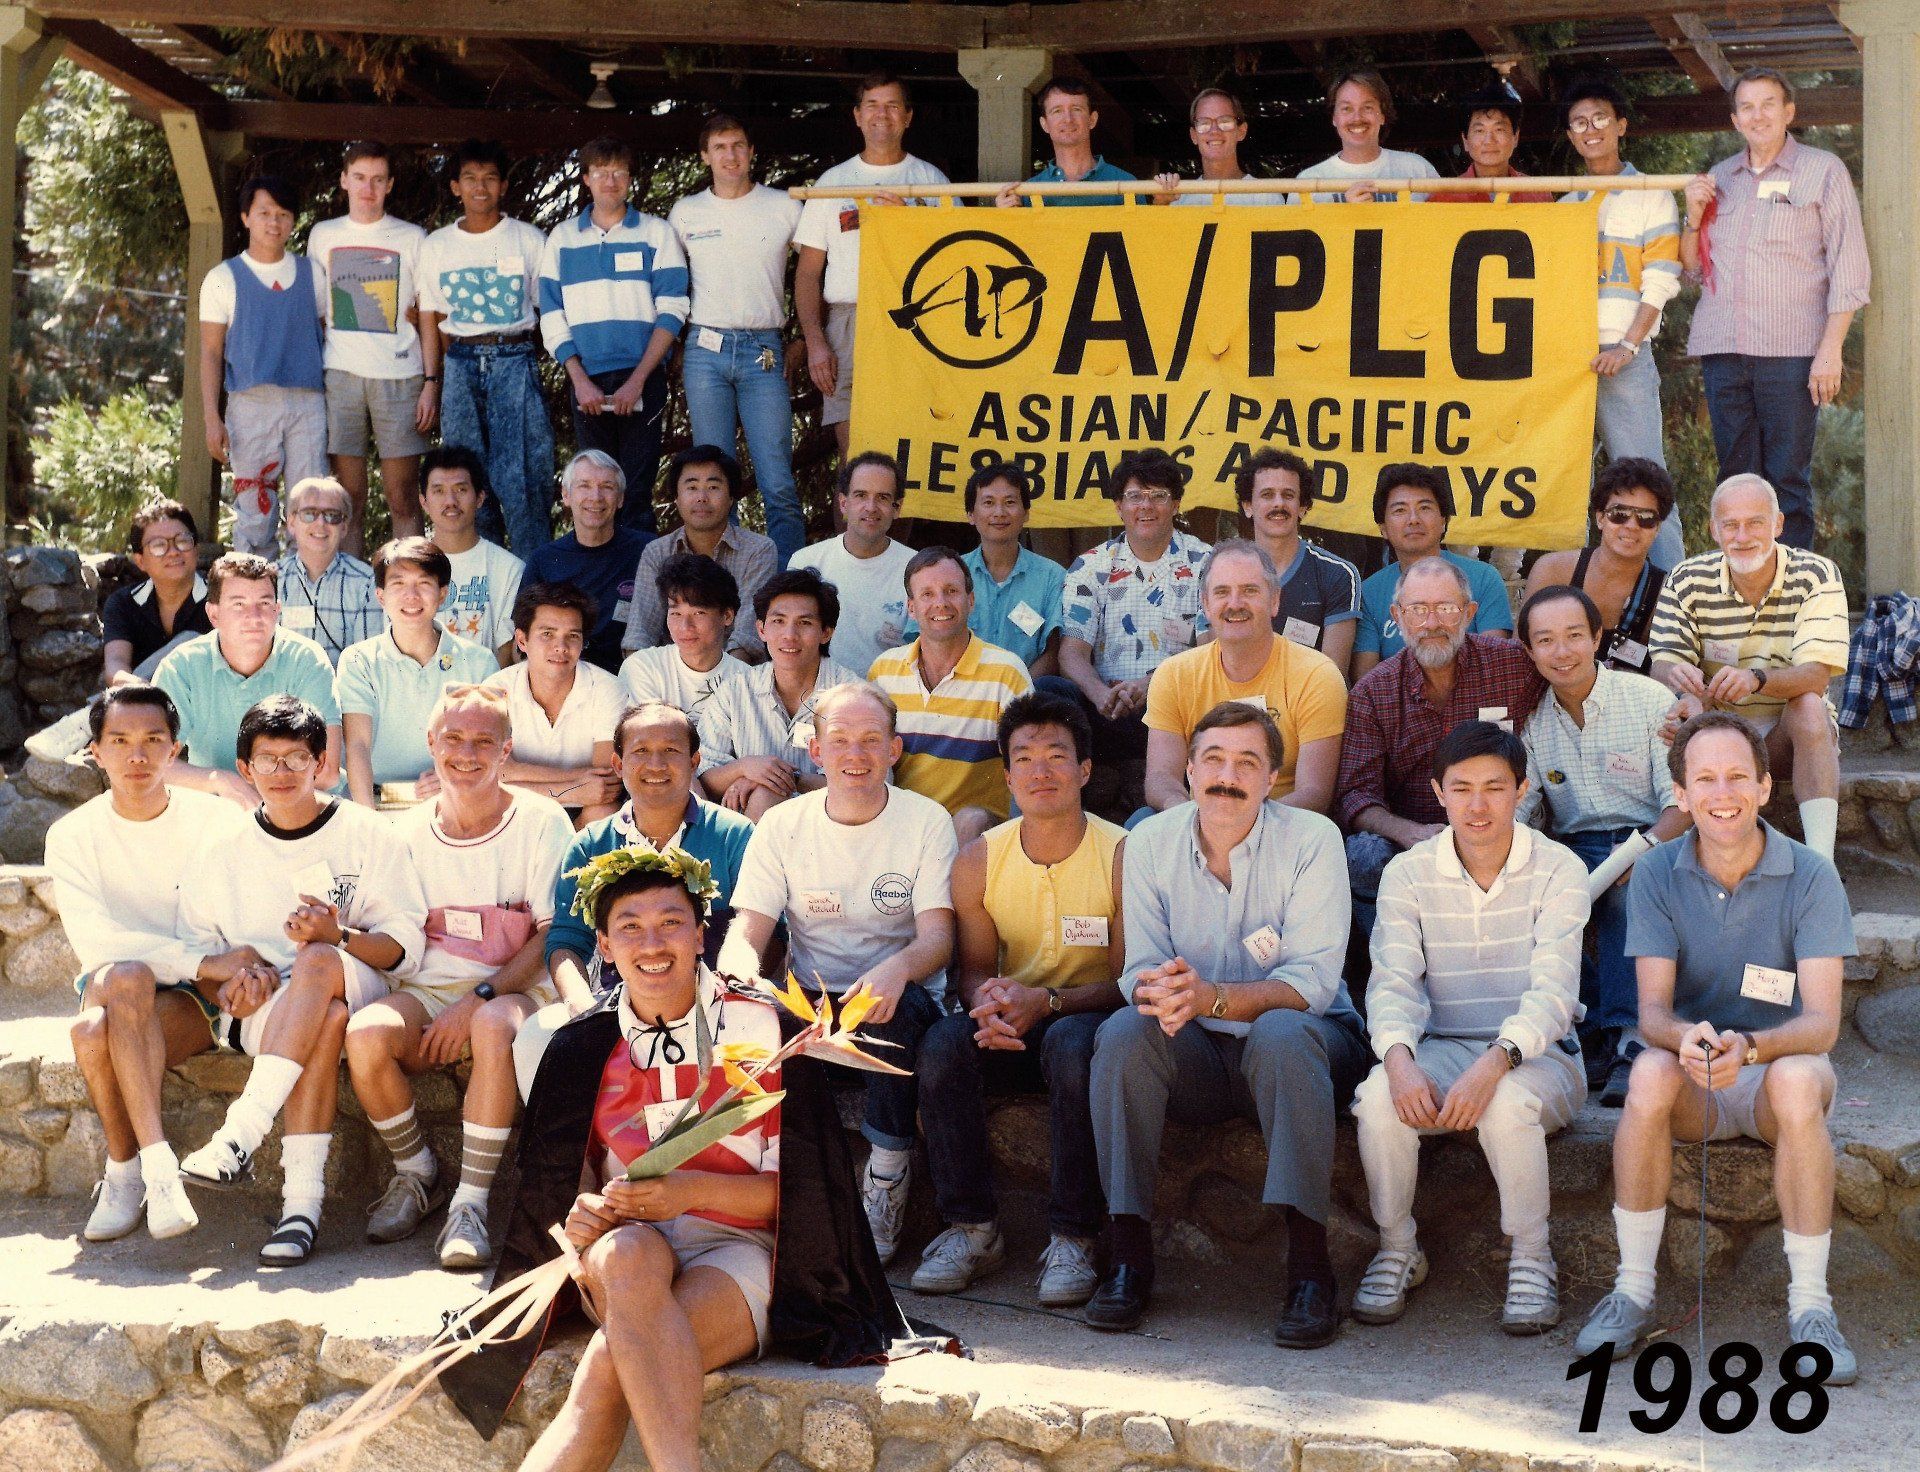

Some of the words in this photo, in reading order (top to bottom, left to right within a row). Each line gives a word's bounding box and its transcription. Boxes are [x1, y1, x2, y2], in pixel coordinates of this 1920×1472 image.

[1053, 224, 1535, 382] A/PLG
[897, 438, 1195, 501] LEBIAS
[1215, 442, 1349, 504] AD
[874, 889, 912, 899] Reebok
[1075, 919, 1091, 929] Bob
